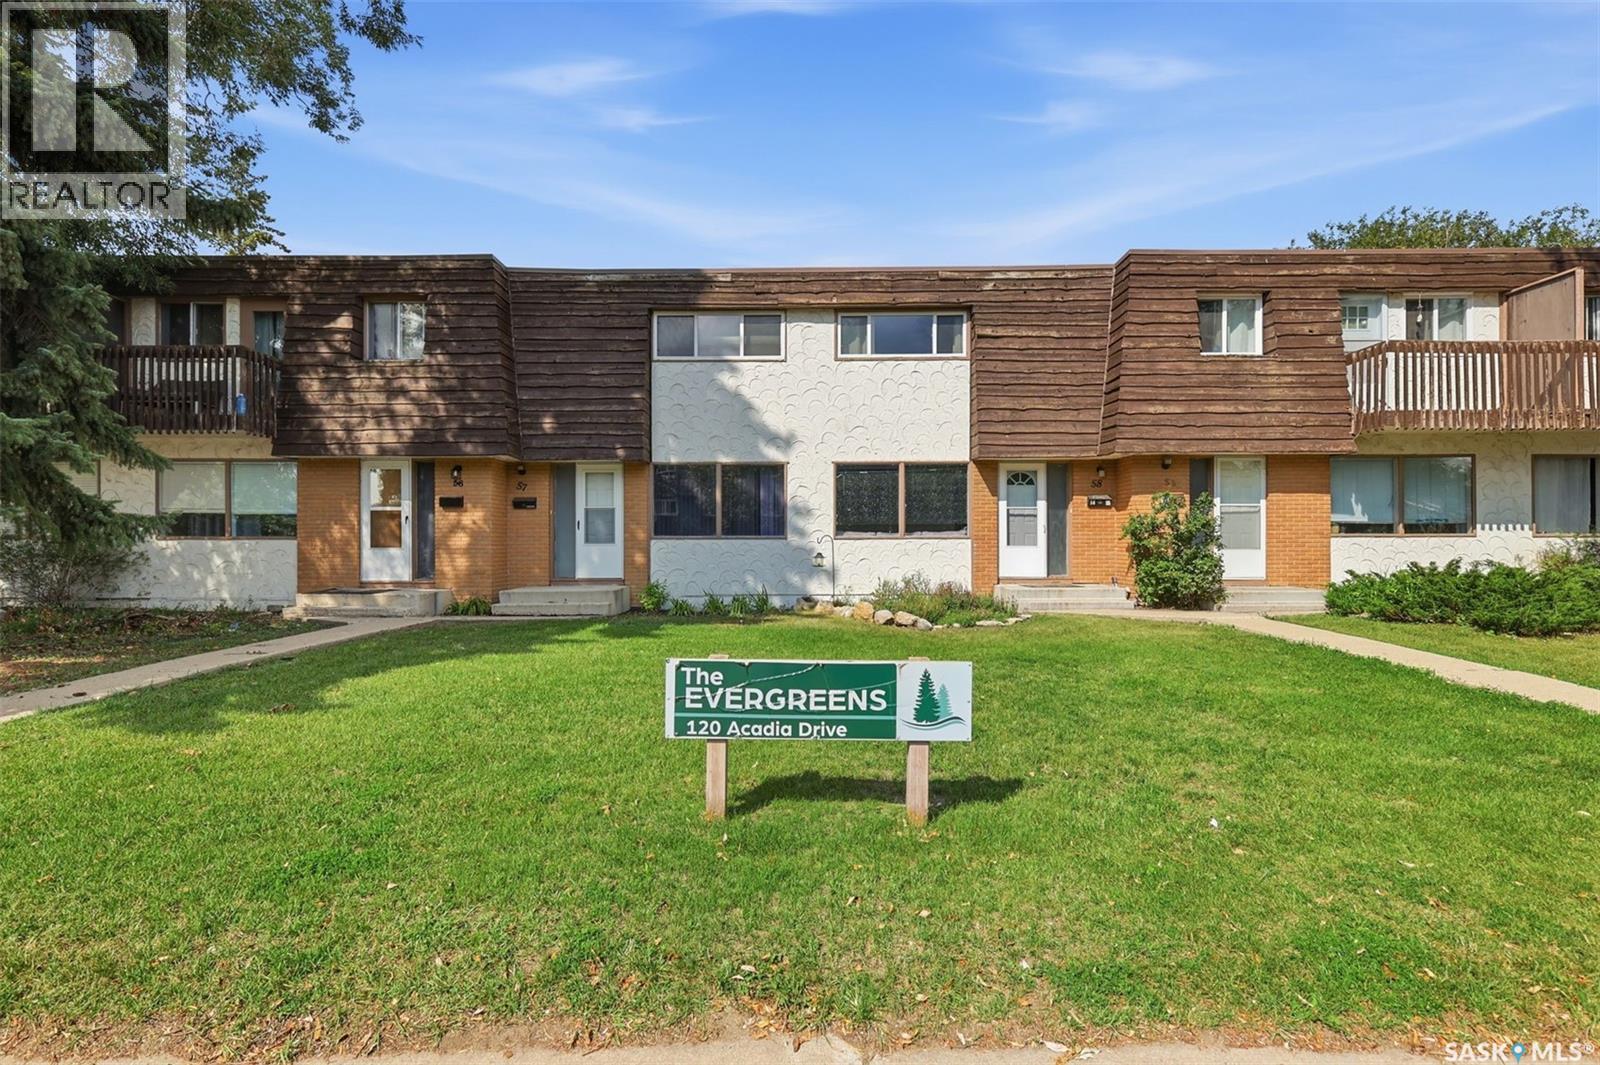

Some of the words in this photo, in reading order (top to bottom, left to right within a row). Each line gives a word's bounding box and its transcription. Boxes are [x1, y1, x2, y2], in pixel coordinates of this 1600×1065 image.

[515, 481, 528, 492] 57
[681, 667, 724, 686] The
[684, 687, 887, 711] EVERGREENS
[686, 720, 721, 736] 120
[726, 720, 793, 737] Acadia
[799, 721, 848, 738] Drive
